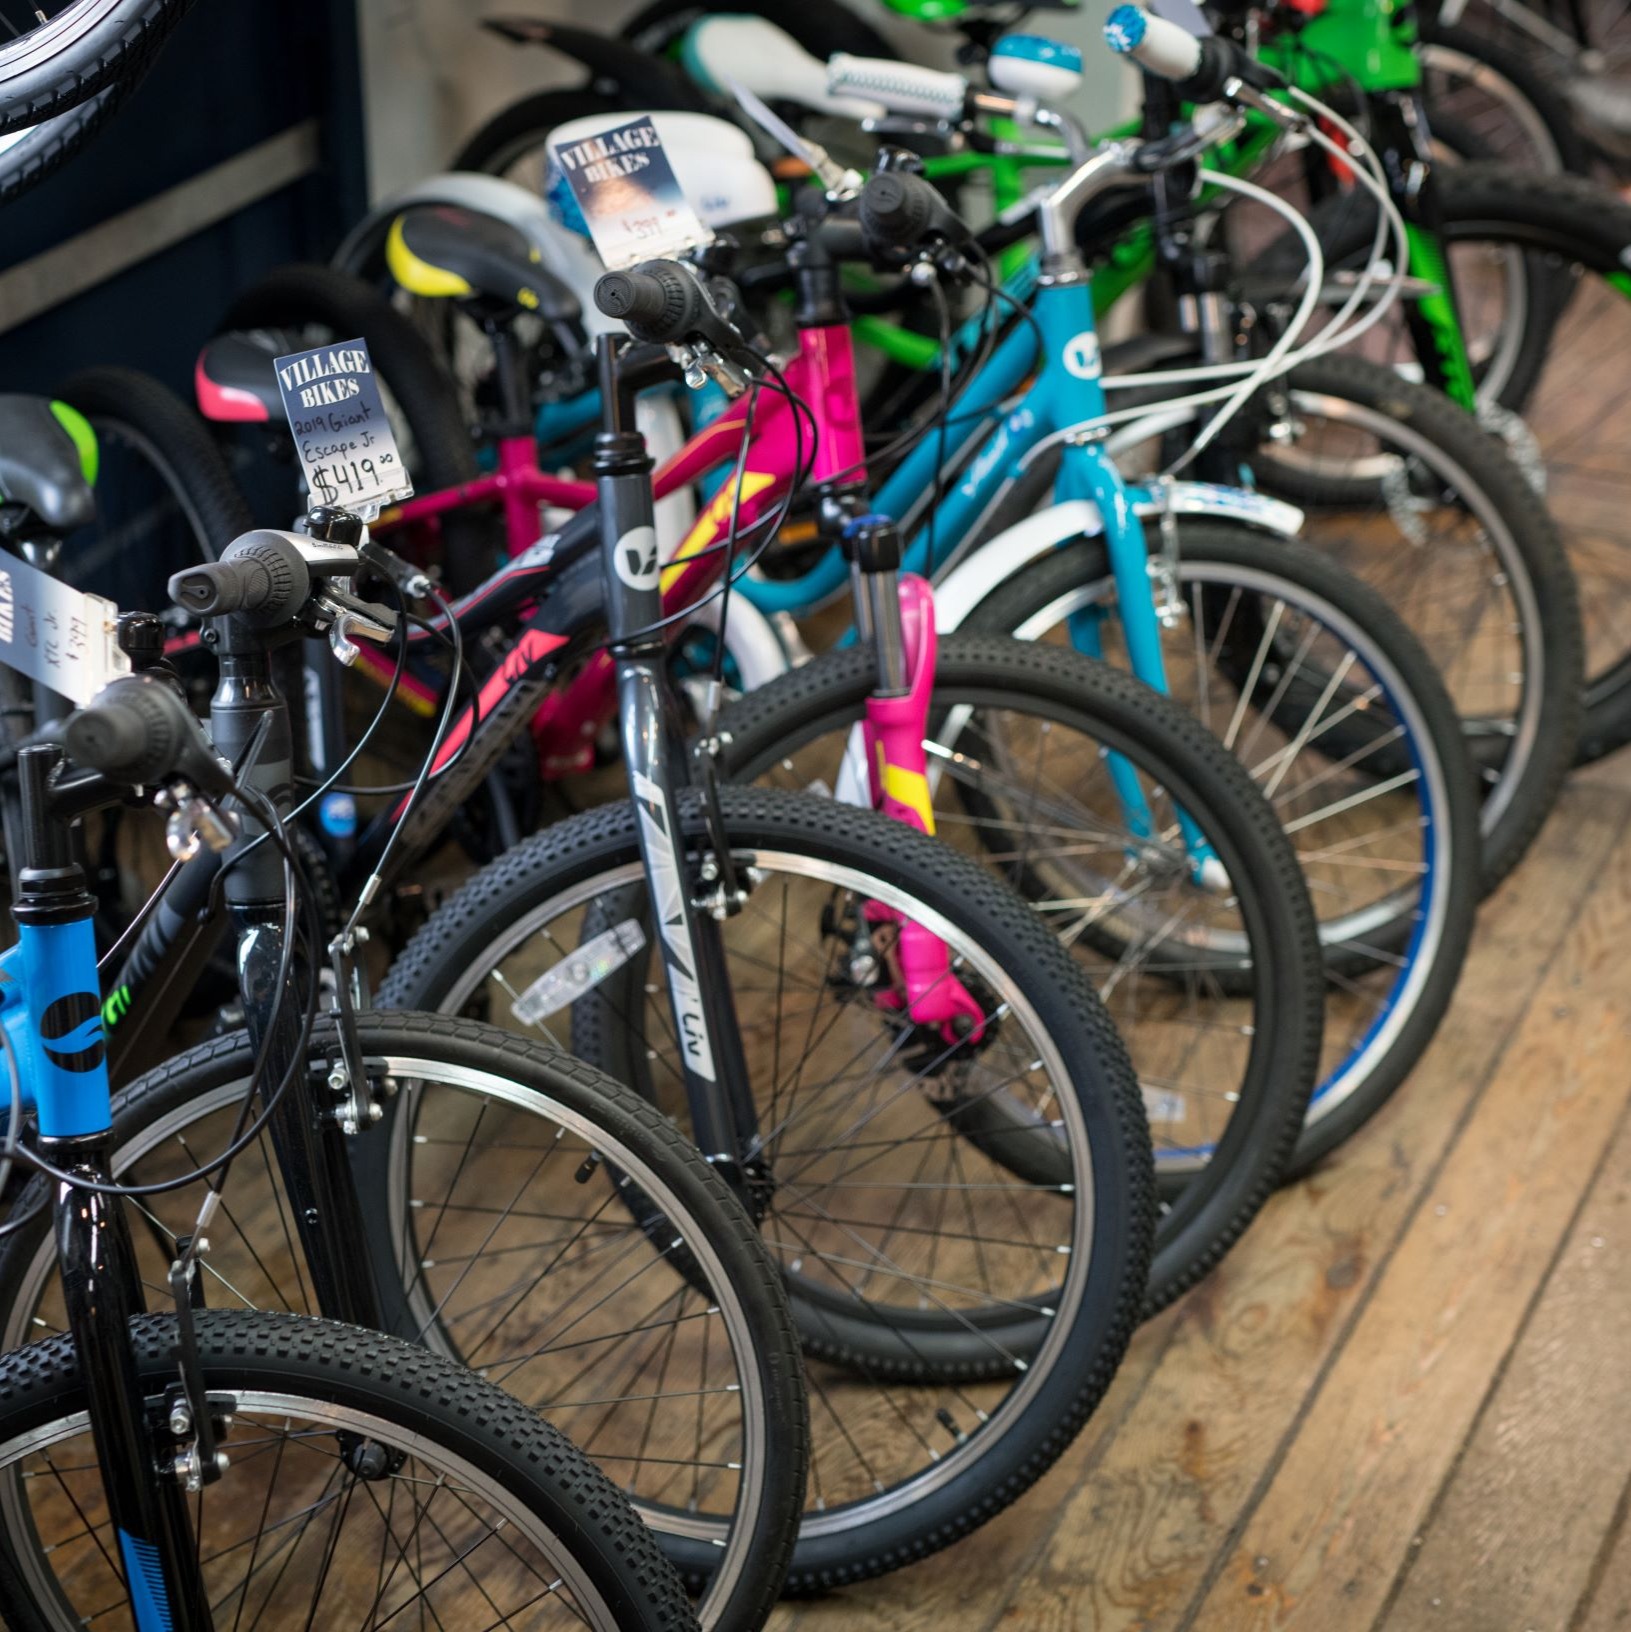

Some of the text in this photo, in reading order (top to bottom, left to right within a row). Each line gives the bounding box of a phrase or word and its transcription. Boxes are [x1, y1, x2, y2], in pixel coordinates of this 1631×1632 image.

[560, 126, 661, 171] VILLAGE
[584, 152, 650, 183] BIKES
[279, 350, 370, 391] VILLAGE
[300, 378, 360, 408] BIKES
[294, 401, 371, 437] 2019 Giant
[302, 440, 357, 464] Escape
[683, 1012, 703, 1056] Liv
